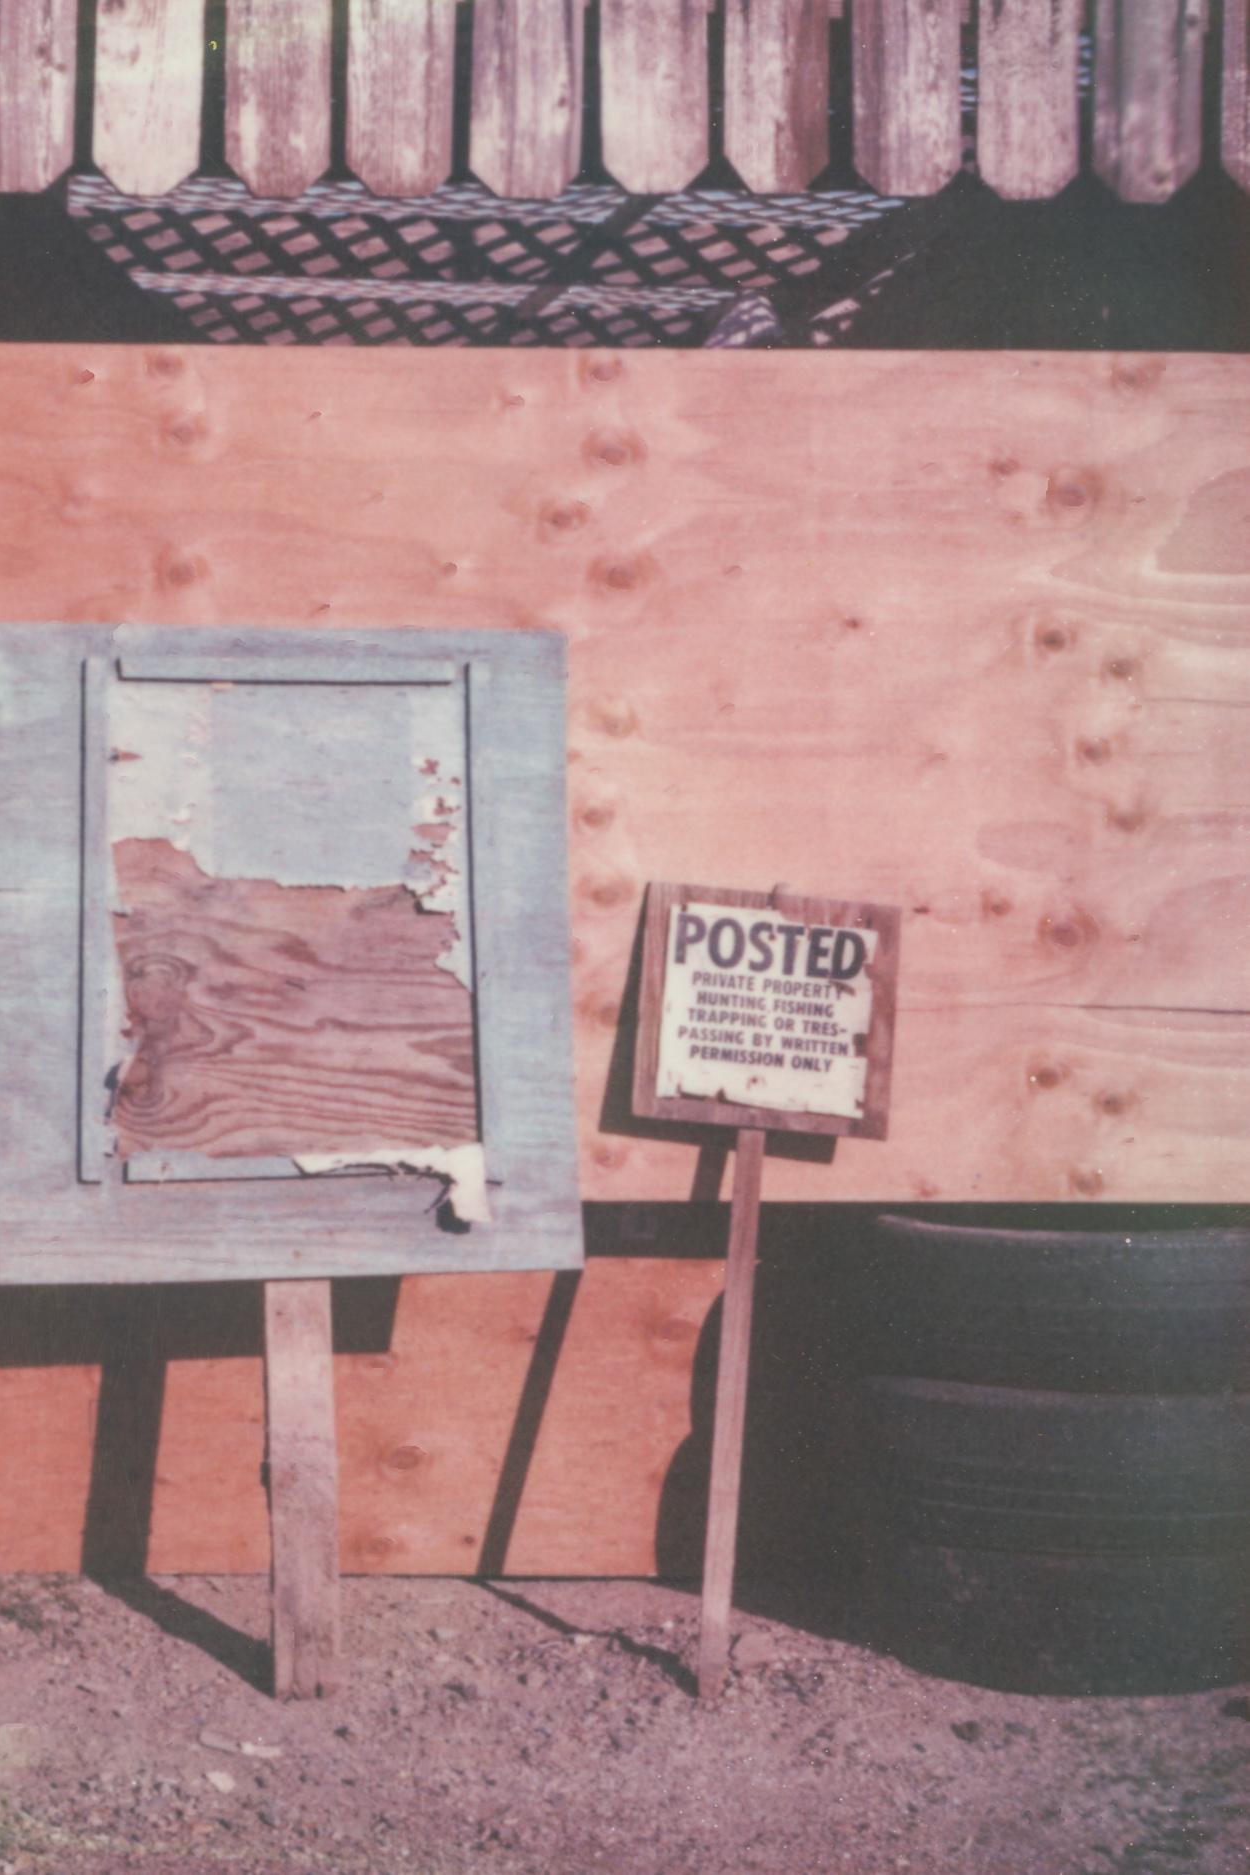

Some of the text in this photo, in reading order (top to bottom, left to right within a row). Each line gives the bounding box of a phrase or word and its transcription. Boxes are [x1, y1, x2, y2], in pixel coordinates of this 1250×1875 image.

[674, 913, 866, 980] POSTED
[692, 971, 845, 1000] PRIVATE PROPERTY
[687, 1008, 847, 1037] TRAPPING OR TRES-
[774, 999, 834, 1018] FISHING
[678, 1026, 848, 1055] PASSING BY WRITTEN
[690, 1045, 832, 1072] PERMISSION ONLY
